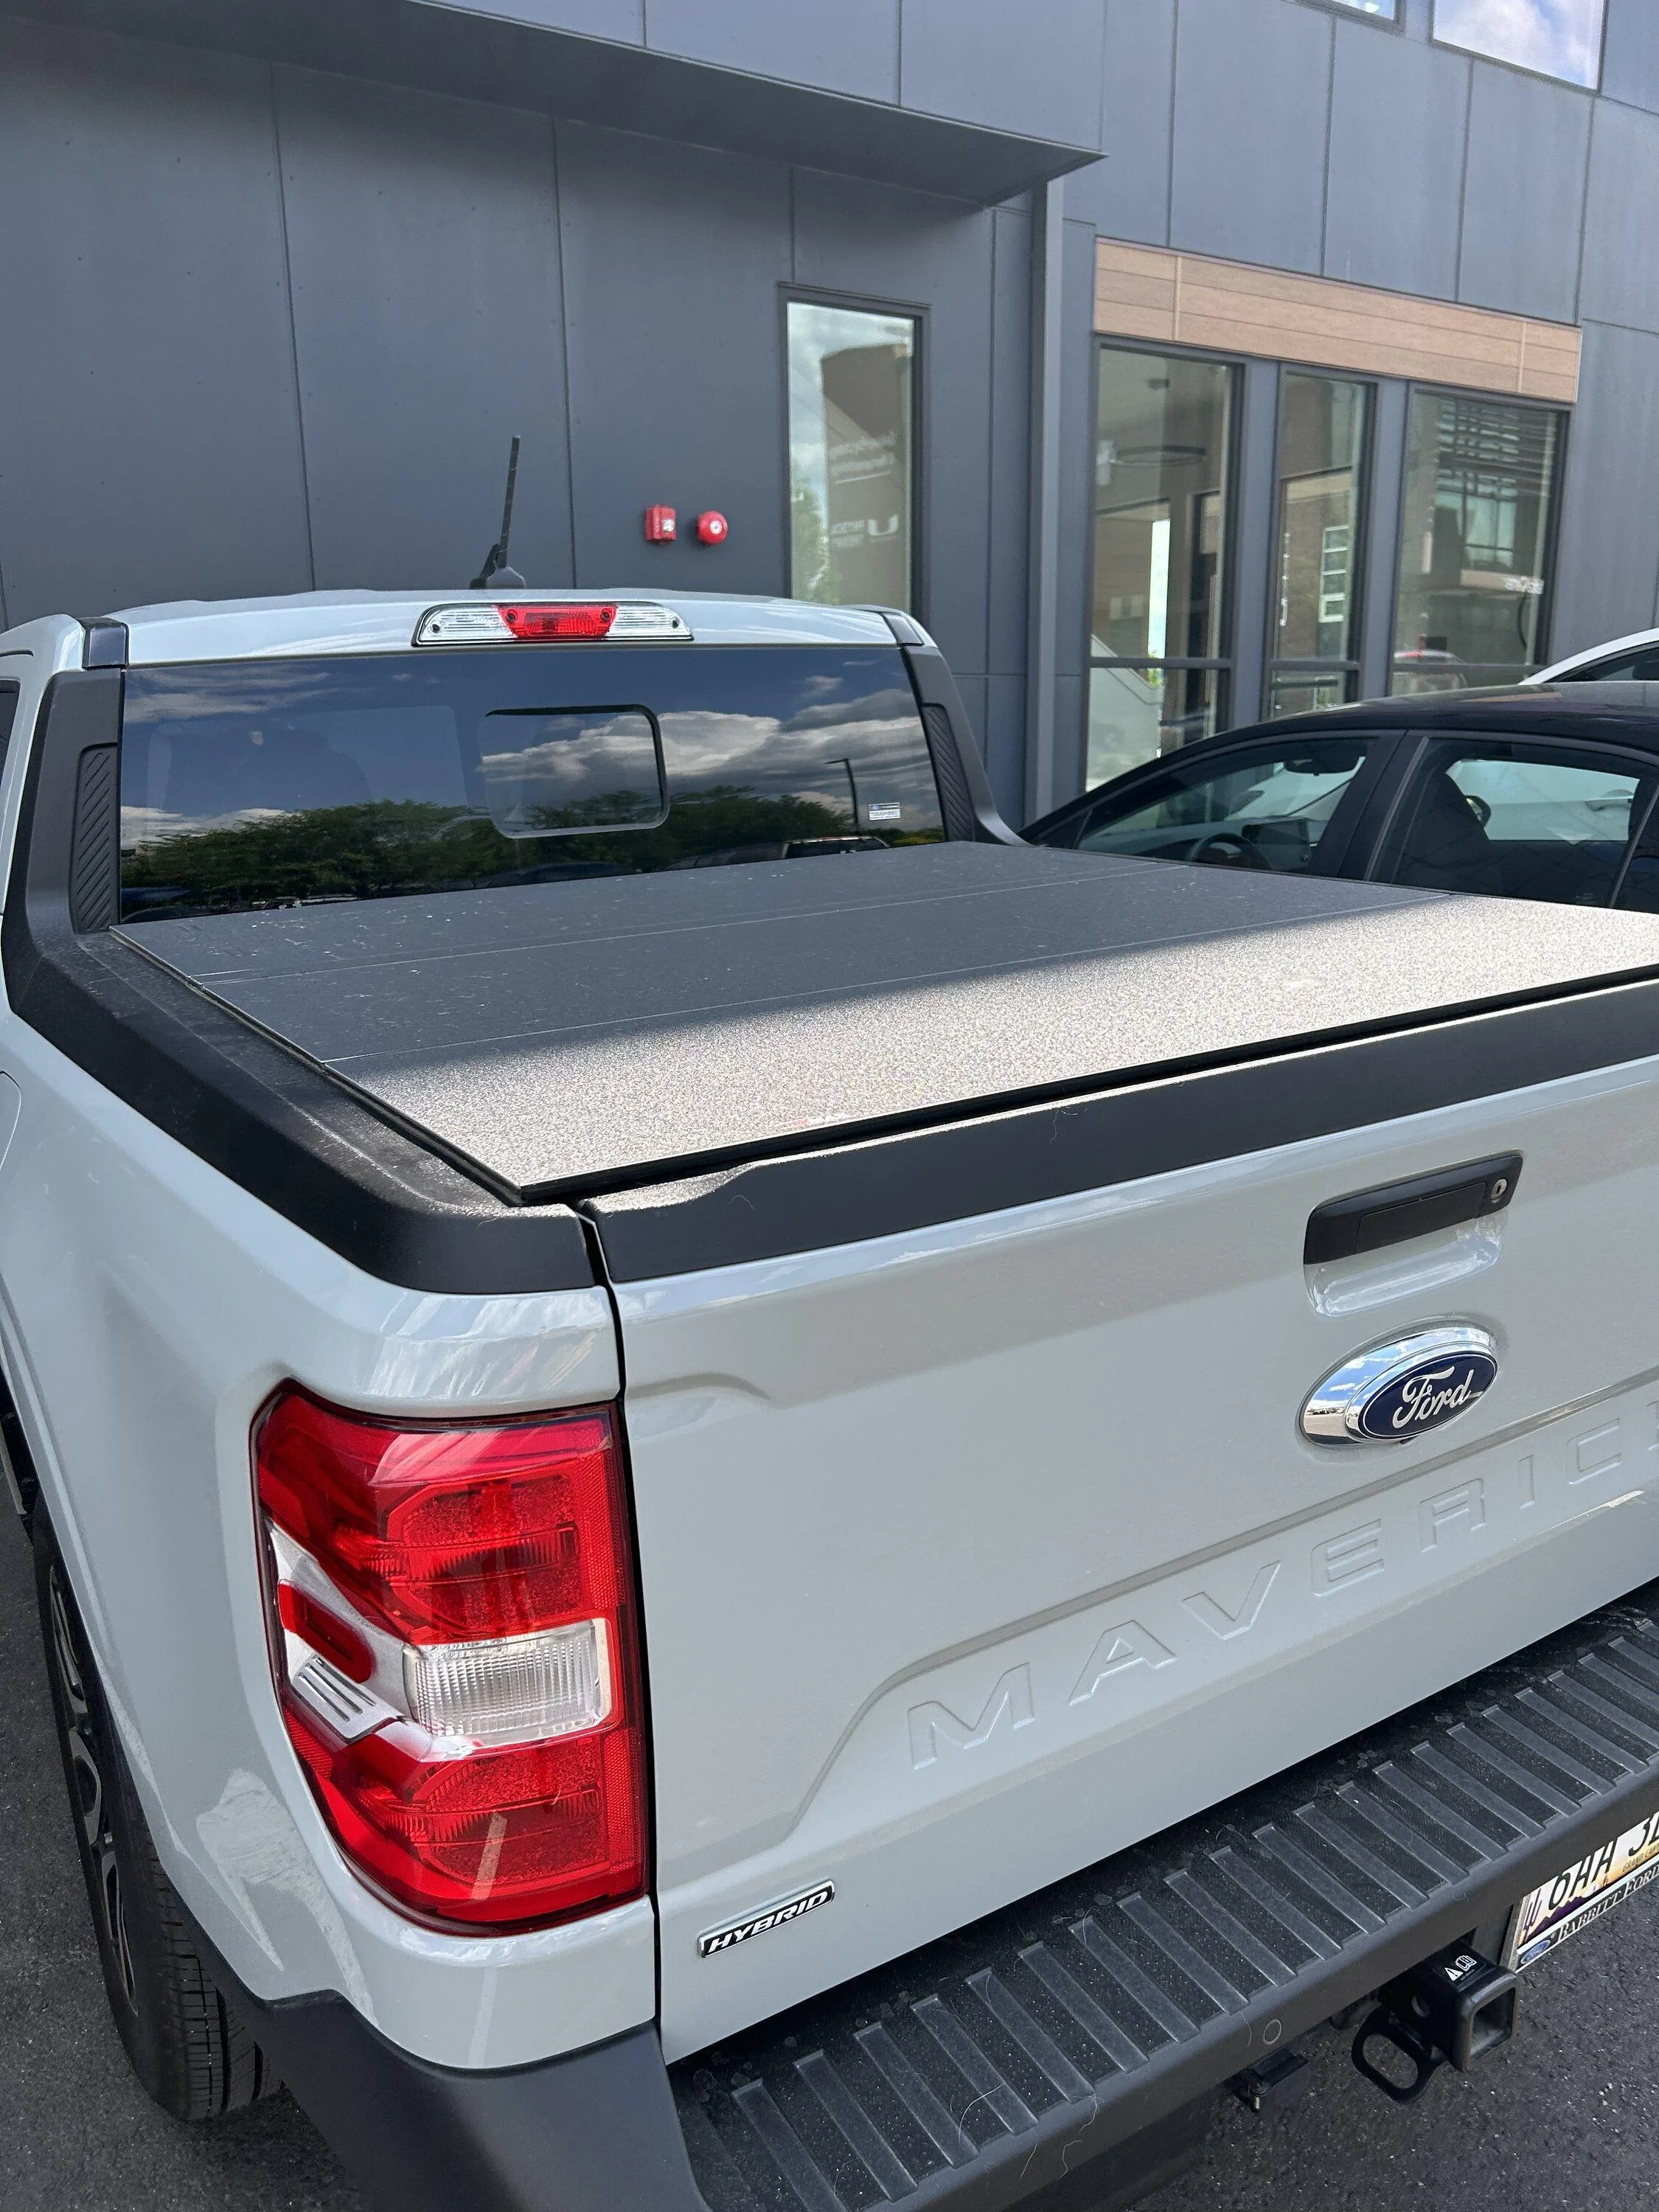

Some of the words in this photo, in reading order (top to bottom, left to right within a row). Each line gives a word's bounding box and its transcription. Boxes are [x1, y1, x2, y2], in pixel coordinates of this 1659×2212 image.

[1392, 1365, 1482, 1429] Ford
[907, 1397, 1659, 1770] MAVERIC
[708, 1891, 828, 1953] HYBRID
[1556, 1890, 1622, 1944] BABBITT
